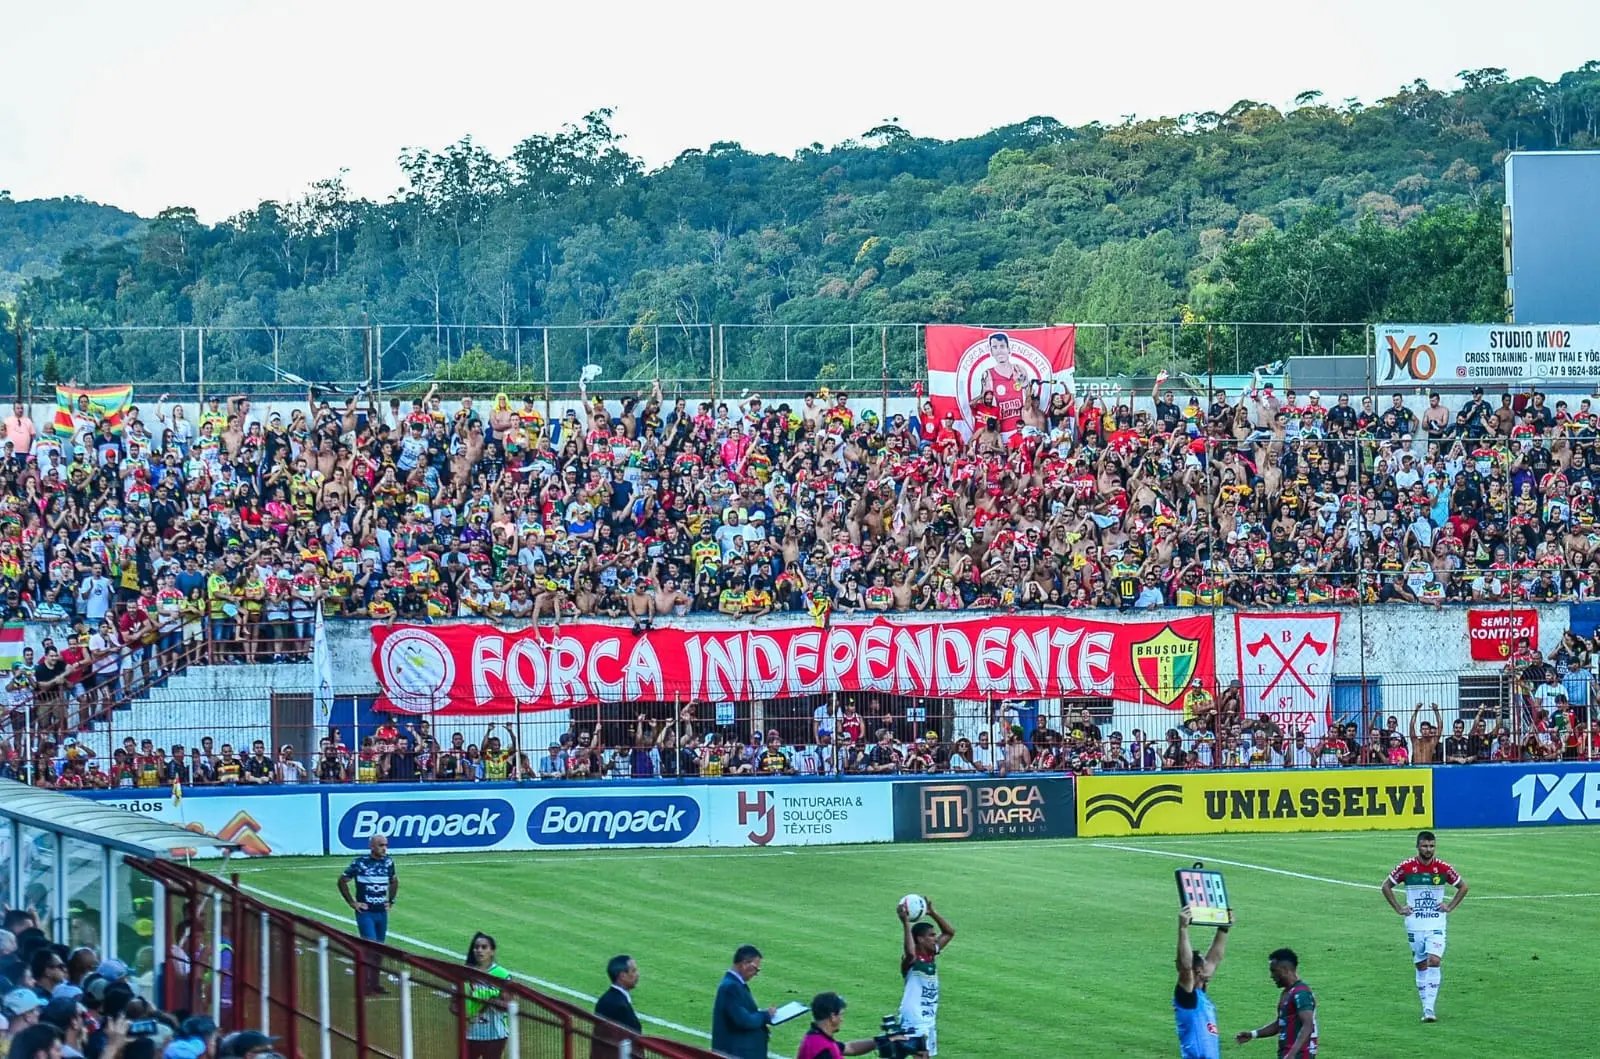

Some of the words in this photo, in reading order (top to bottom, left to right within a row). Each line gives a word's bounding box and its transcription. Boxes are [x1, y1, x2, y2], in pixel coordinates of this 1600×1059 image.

[1490, 330, 1533, 348] STUDIO
[1537, 330, 1571, 348] MVO2
[1465, 351, 1490, 363] CROSS
[1492, 351, 1528, 363] TRAINING
[1535, 351, 1556, 362] MUAY
[1559, 351, 1576, 362] THAI
[1577, 351, 1583, 362] E
[1549, 366, 1559, 376] 47
[1561, 366, 1566, 376] 9
[1121, 581, 1133, 596] 10
[1481, 616, 1524, 627] SEMPRE
[1281, 630, 1292, 643] B
[1471, 626, 1535, 640] CONTIGO!
[1137, 643, 1194, 656] BRUSQUE
[683, 623, 1115, 700] INDEPENDENTE
[1258, 664, 1267, 676] F
[1306, 663, 1319, 676] C
[1279, 696, 1294, 709] 87
[782, 796, 853, 808] TINTURARIA
[855, 796, 863, 807] &
[977, 785, 1046, 807] BOCA
[1204, 785, 1426, 820] UNIASSELVI
[541, 804, 687, 840] Bompack
[783, 808, 849, 823] SOLUÇÕES
[977, 808, 1046, 825] MAFRA
[352, 807, 501, 843] Bompack
[783, 822, 833, 834] TÊXTEIS
